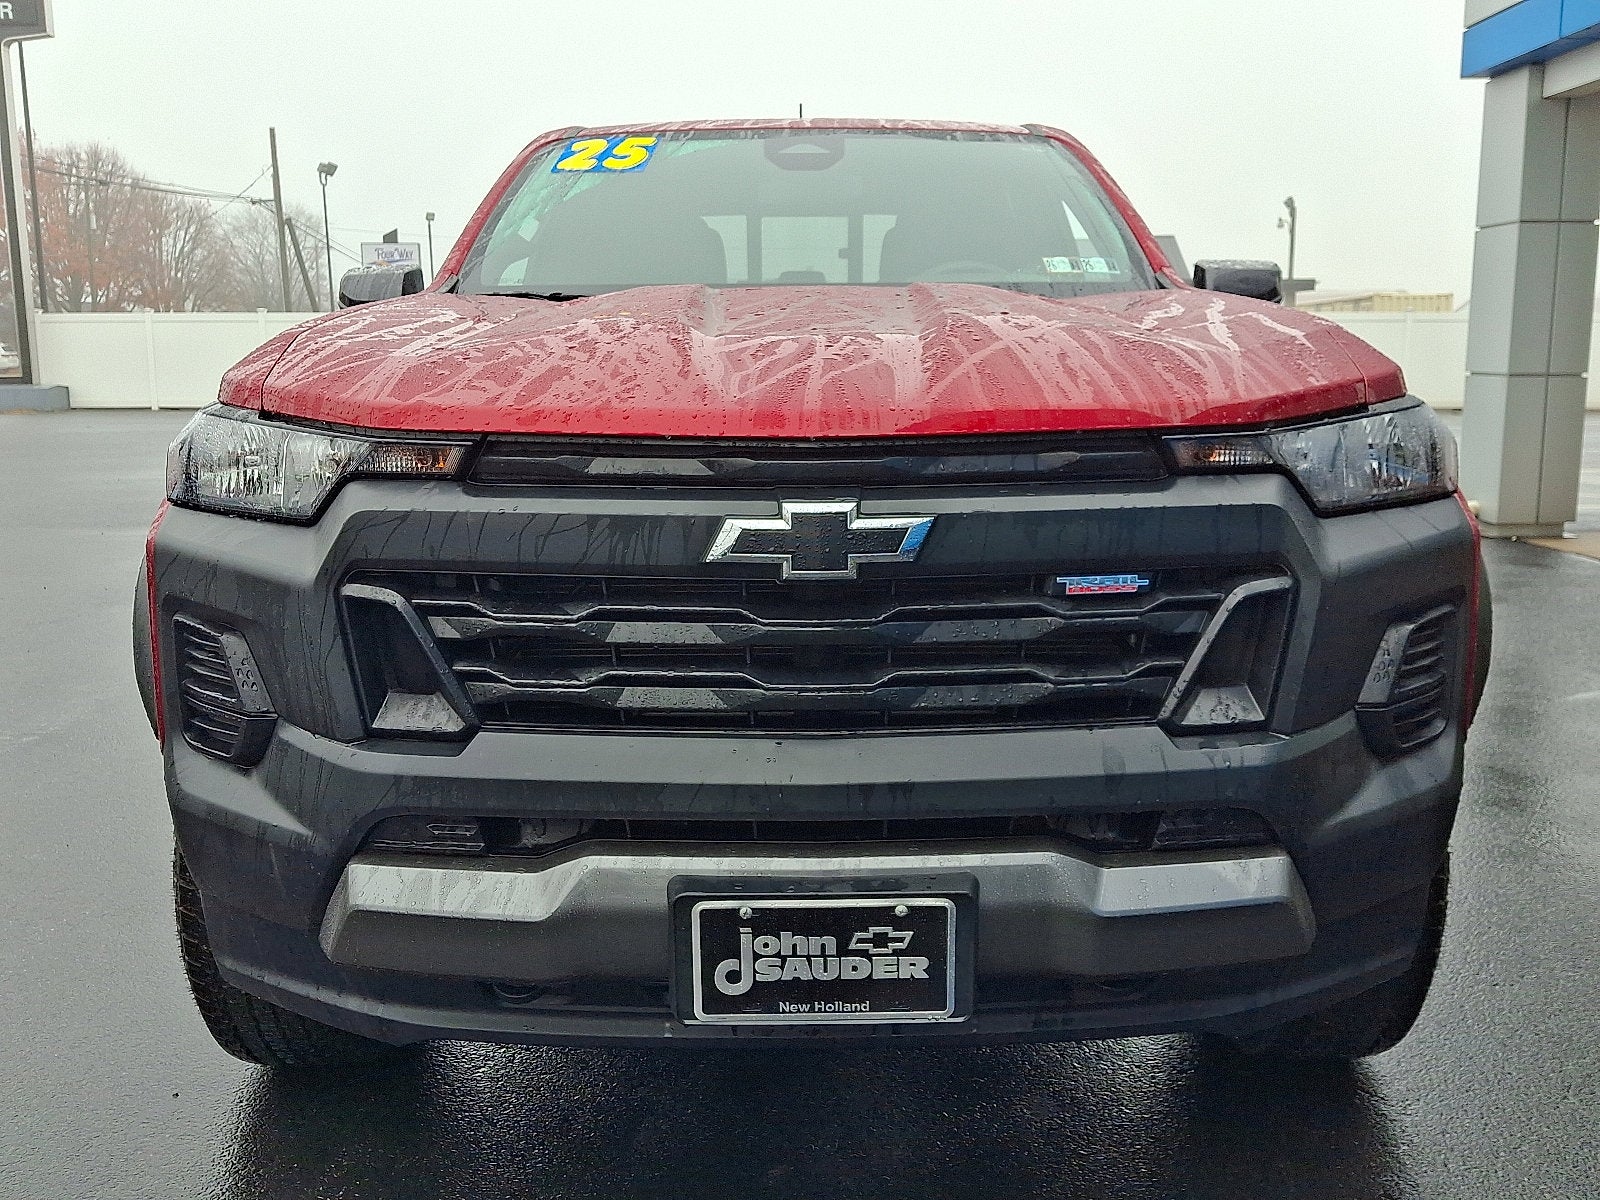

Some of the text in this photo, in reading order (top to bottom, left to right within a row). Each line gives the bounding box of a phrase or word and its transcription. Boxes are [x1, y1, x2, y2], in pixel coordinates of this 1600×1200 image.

[556, 136, 658, 171] 25
[755, 956, 930, 981] SAUDER
[779, 1000, 870, 1013] New Holland
